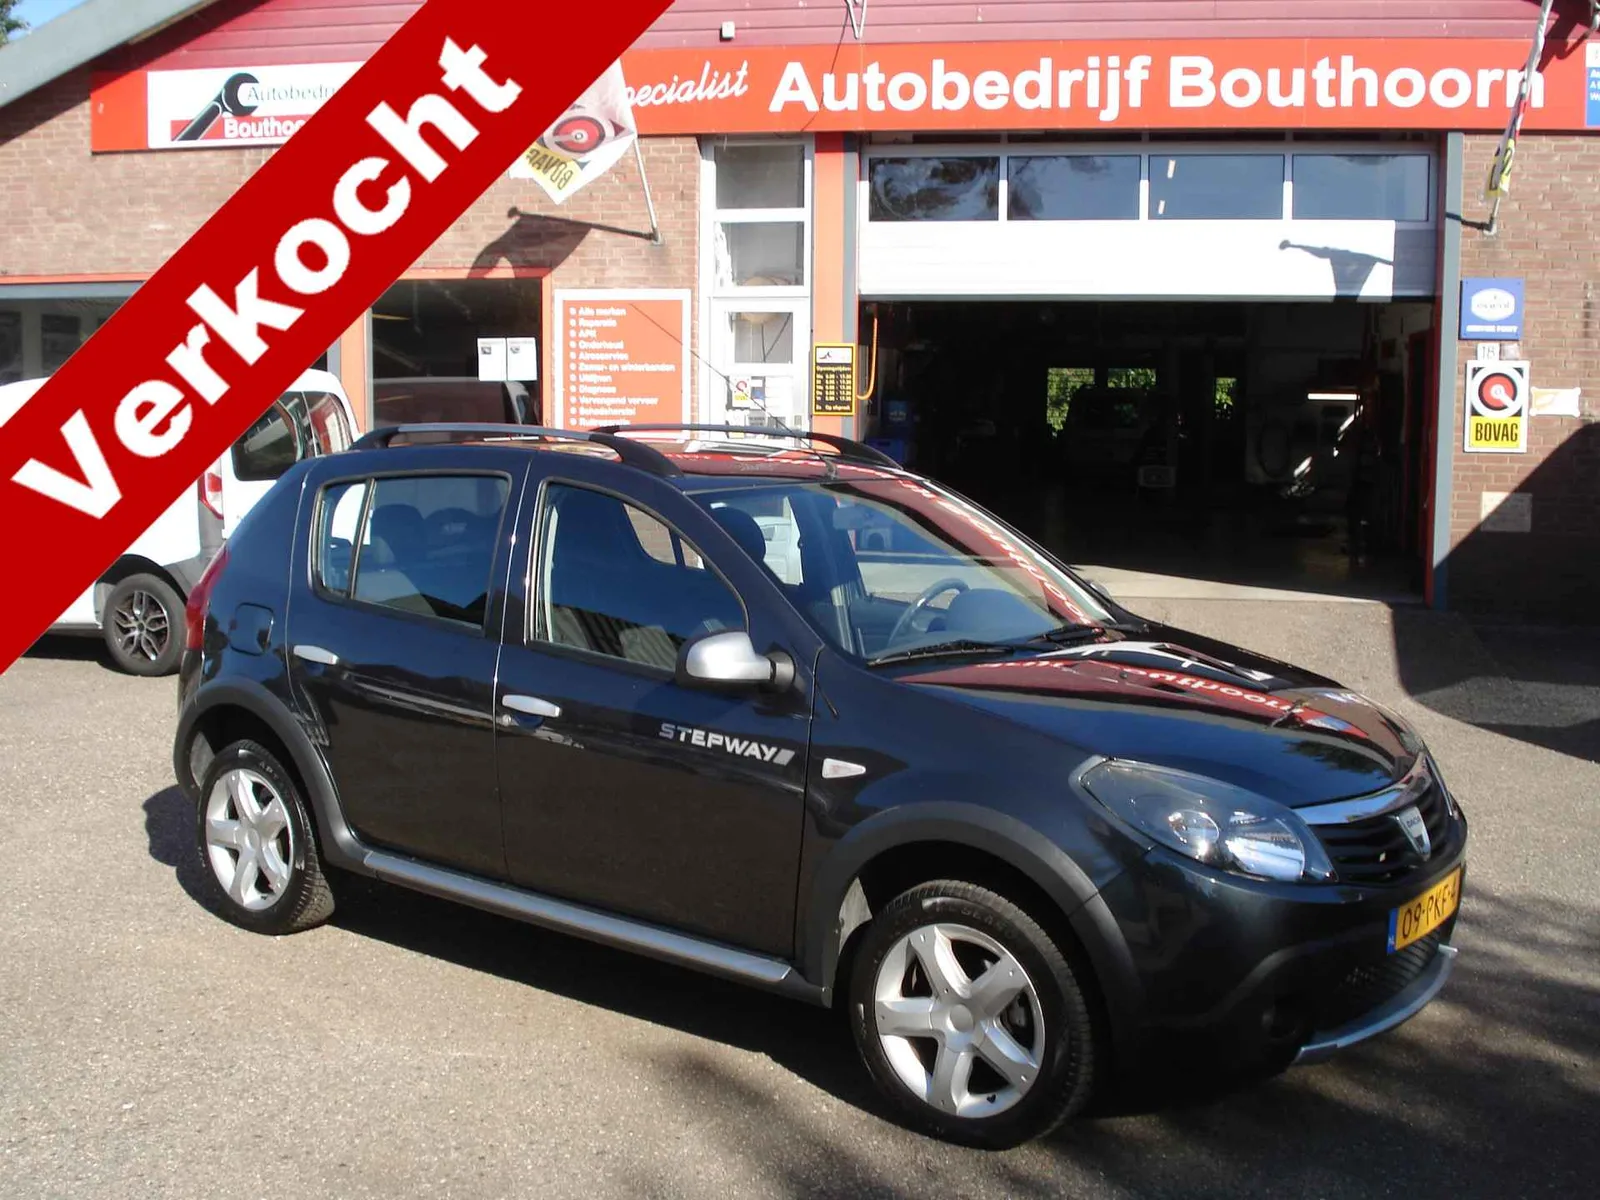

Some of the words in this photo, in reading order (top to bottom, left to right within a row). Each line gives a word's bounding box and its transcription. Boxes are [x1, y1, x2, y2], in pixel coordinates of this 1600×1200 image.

[247, 84, 336, 101] Autobedr
[625, 60, 748, 107] pecialist
[768, 55, 1152, 122] Autobedrijf
[1169, 55, 1545, 109] Bouthoorn
[1474, 422, 1519, 442] BOVAG
[659, 722, 778, 762] STEPWAY
